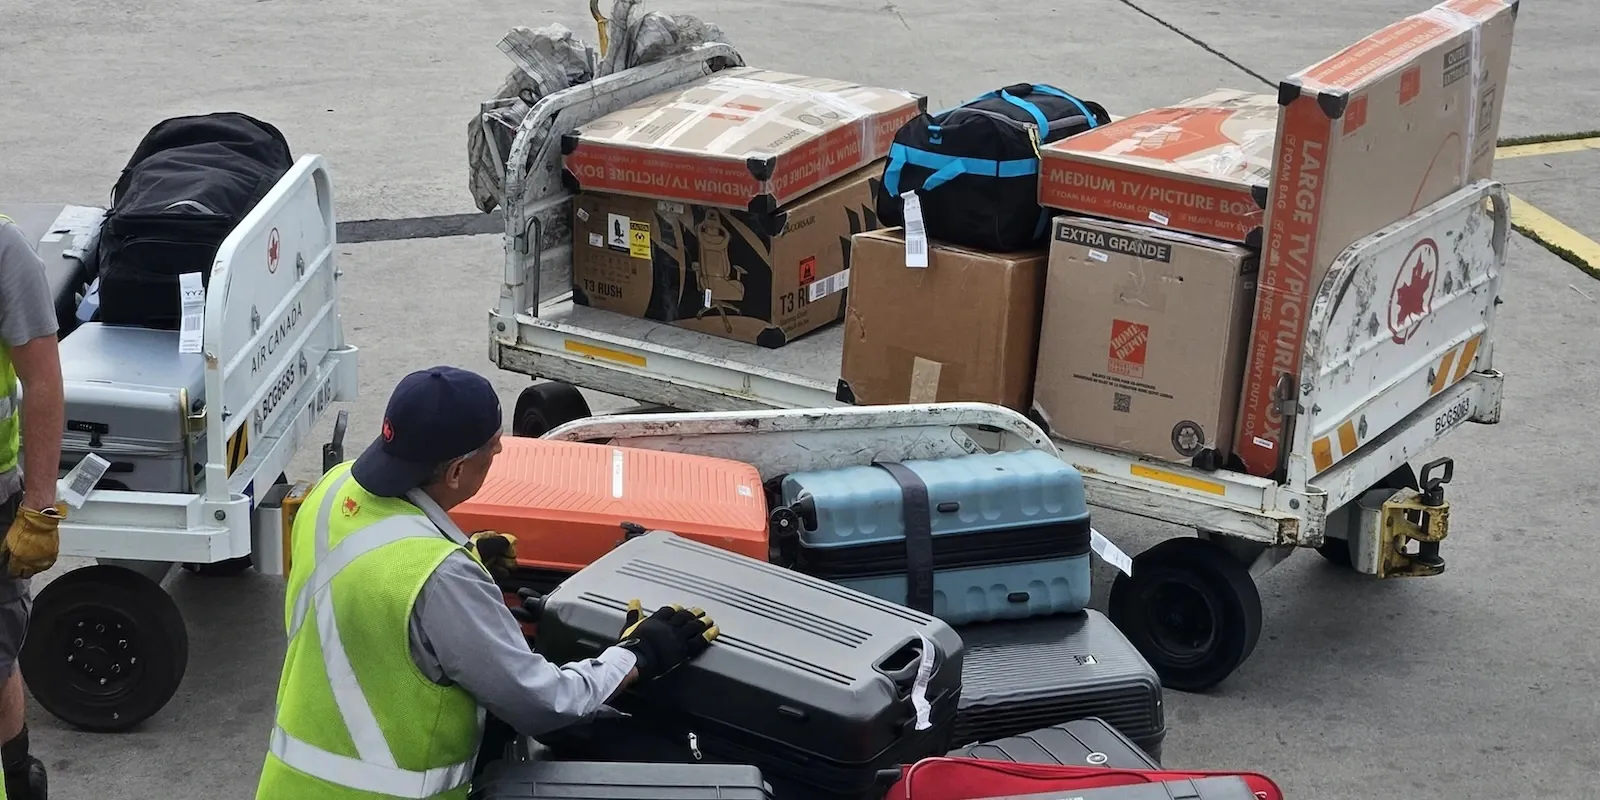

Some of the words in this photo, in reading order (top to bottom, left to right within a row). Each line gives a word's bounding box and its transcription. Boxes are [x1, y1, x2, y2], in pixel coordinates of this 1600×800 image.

[574, 163, 605, 178] BOX
[608, 166, 688, 189] TV/PICTURE
[1280, 147, 1294, 182] FOAM
[694, 179, 754, 197] MEDIUM
[1050, 168, 1116, 194] MEDIUM
[1121, 182, 1214, 211] TV/PICTURE
[1275, 184, 1289, 209] BAG
[1293, 139, 1323, 225] LARGE
[789, 215, 816, 231] CORSAIR
[1055, 189, 1080, 201] FOAM
[1080, 193, 1098, 205] BAG
[1112, 200, 1135, 211] FOAM
[1188, 215, 1213, 228] HEAVY
[1214, 219, 1235, 230] DUTY
[1060, 226, 1106, 248] EXTRA
[1108, 236, 1167, 260] GRANDE
[185, 288, 204, 297] YYZ
[583, 278, 596, 292] T3
[597, 284, 623, 300] RUSH
[1262, 270, 1276, 321] CORNERS
[779, 292, 795, 316] T3
[1272, 231, 1311, 378] TV/PICTURE
[251, 344, 268, 373] AIR
[267, 301, 304, 356] CANADA
[1111, 324, 1141, 350] HOME
[1116, 330, 1147, 360] DEPOT
[1253, 344, 1267, 379] HEAVY
[1249, 382, 1261, 410] DUTY
[1244, 412, 1255, 438] BOX
[1434, 397, 1470, 433] BCG5063
